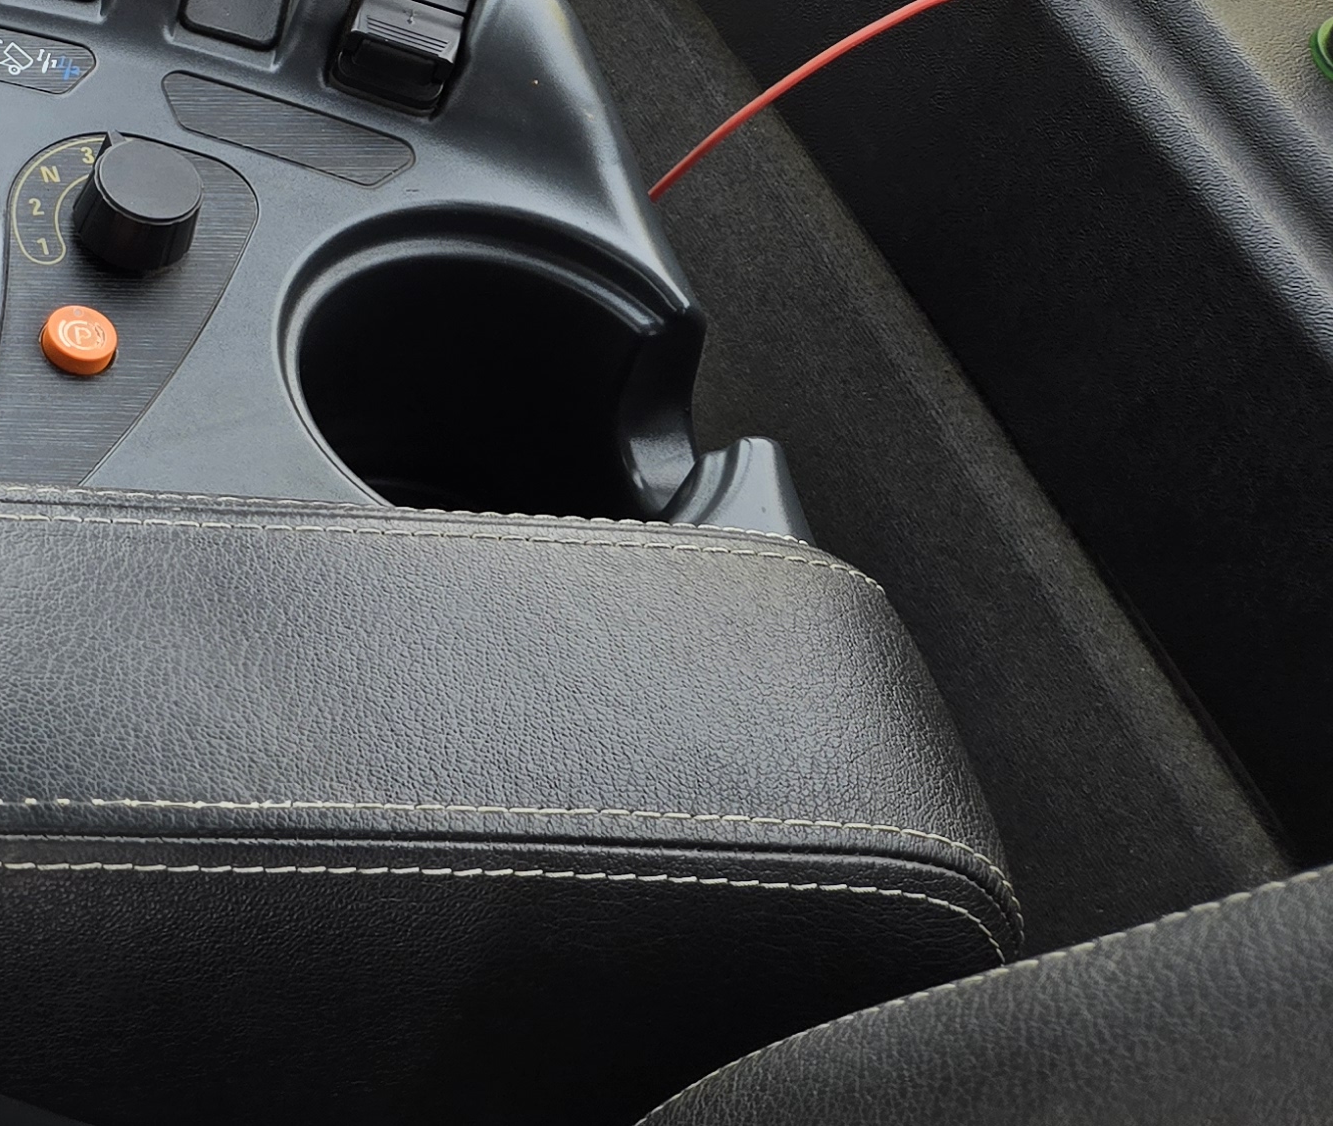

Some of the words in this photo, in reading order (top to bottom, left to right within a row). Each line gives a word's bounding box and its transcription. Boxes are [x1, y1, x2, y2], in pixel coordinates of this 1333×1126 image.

[80, 146, 95, 164] 3
[40, 166, 61, 183] N
[28, 197, 45, 216] 2
[36, 237, 49, 255] 1
